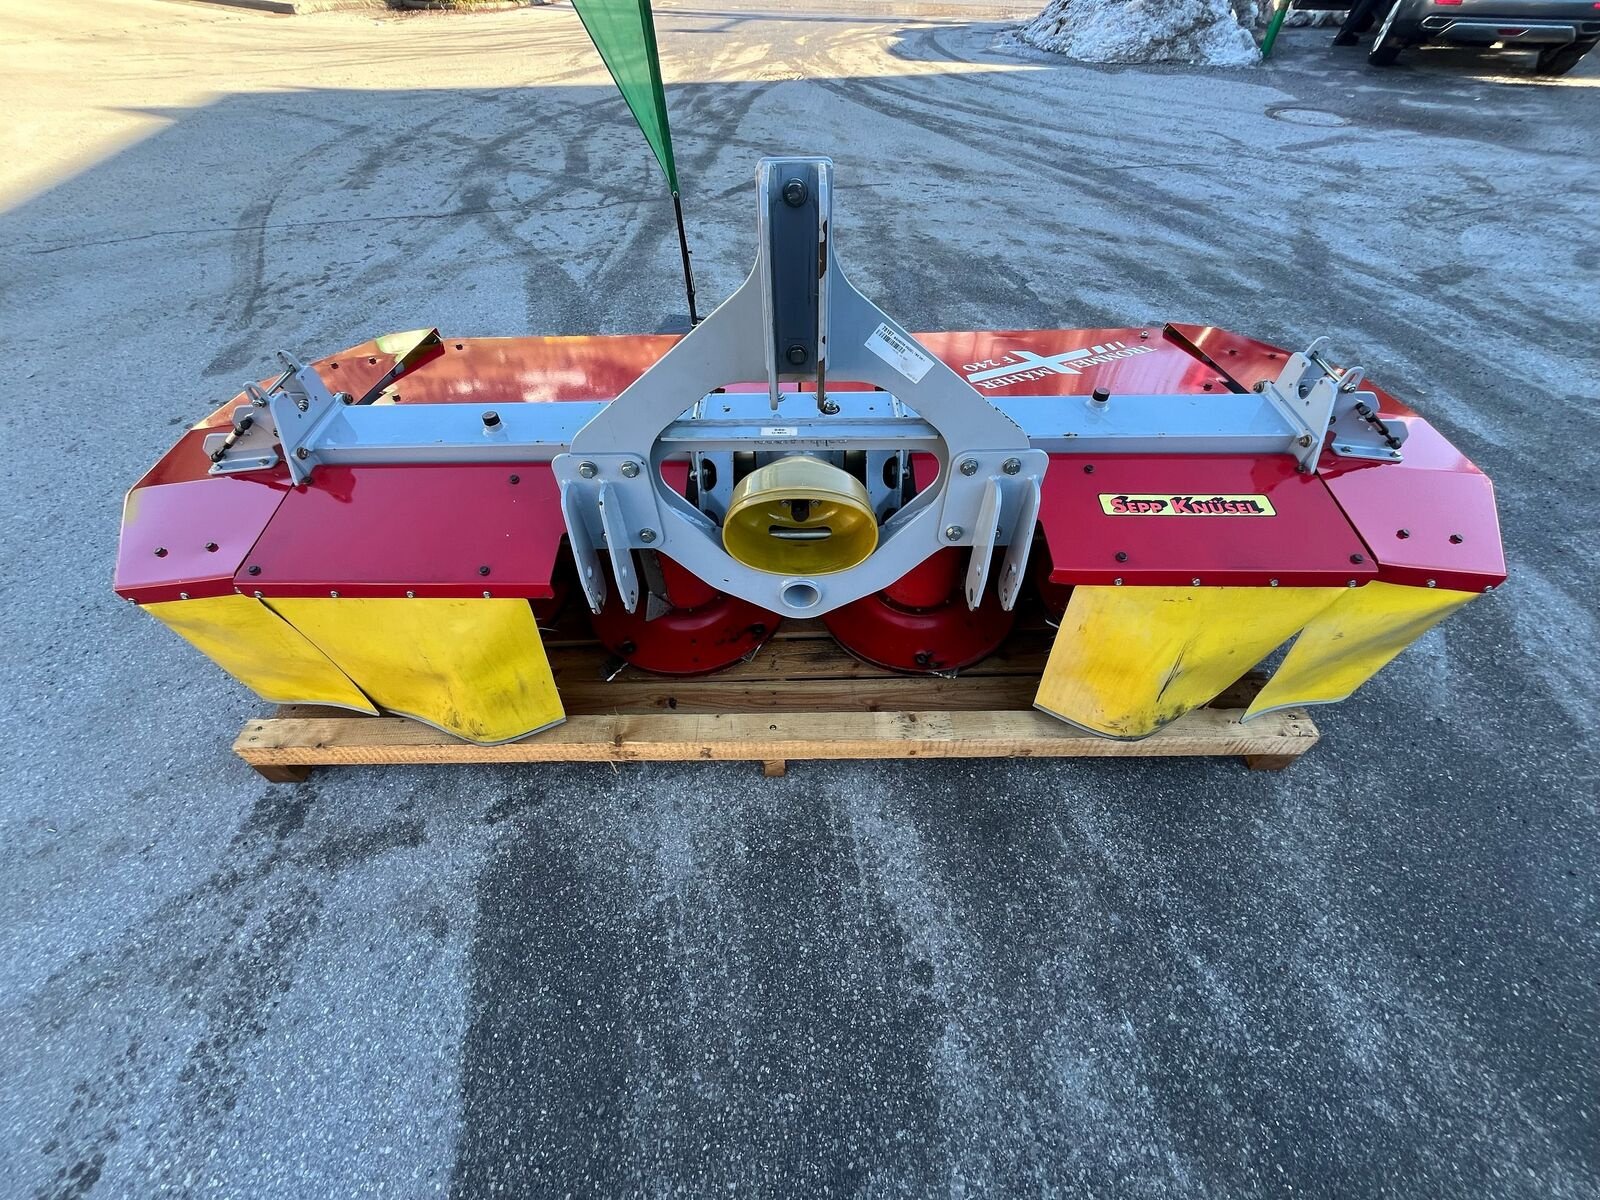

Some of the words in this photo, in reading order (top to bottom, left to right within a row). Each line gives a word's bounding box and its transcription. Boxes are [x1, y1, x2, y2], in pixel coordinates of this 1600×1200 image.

[962, 360, 1001, 372] 240
[1005, 356, 1018, 365] F
[1064, 345, 1157, 369] TROMMEL
[975, 366, 1055, 389] MÄHER
[1110, 496, 1167, 513] SEPP
[1169, 496, 1265, 514] KNÜSEL
